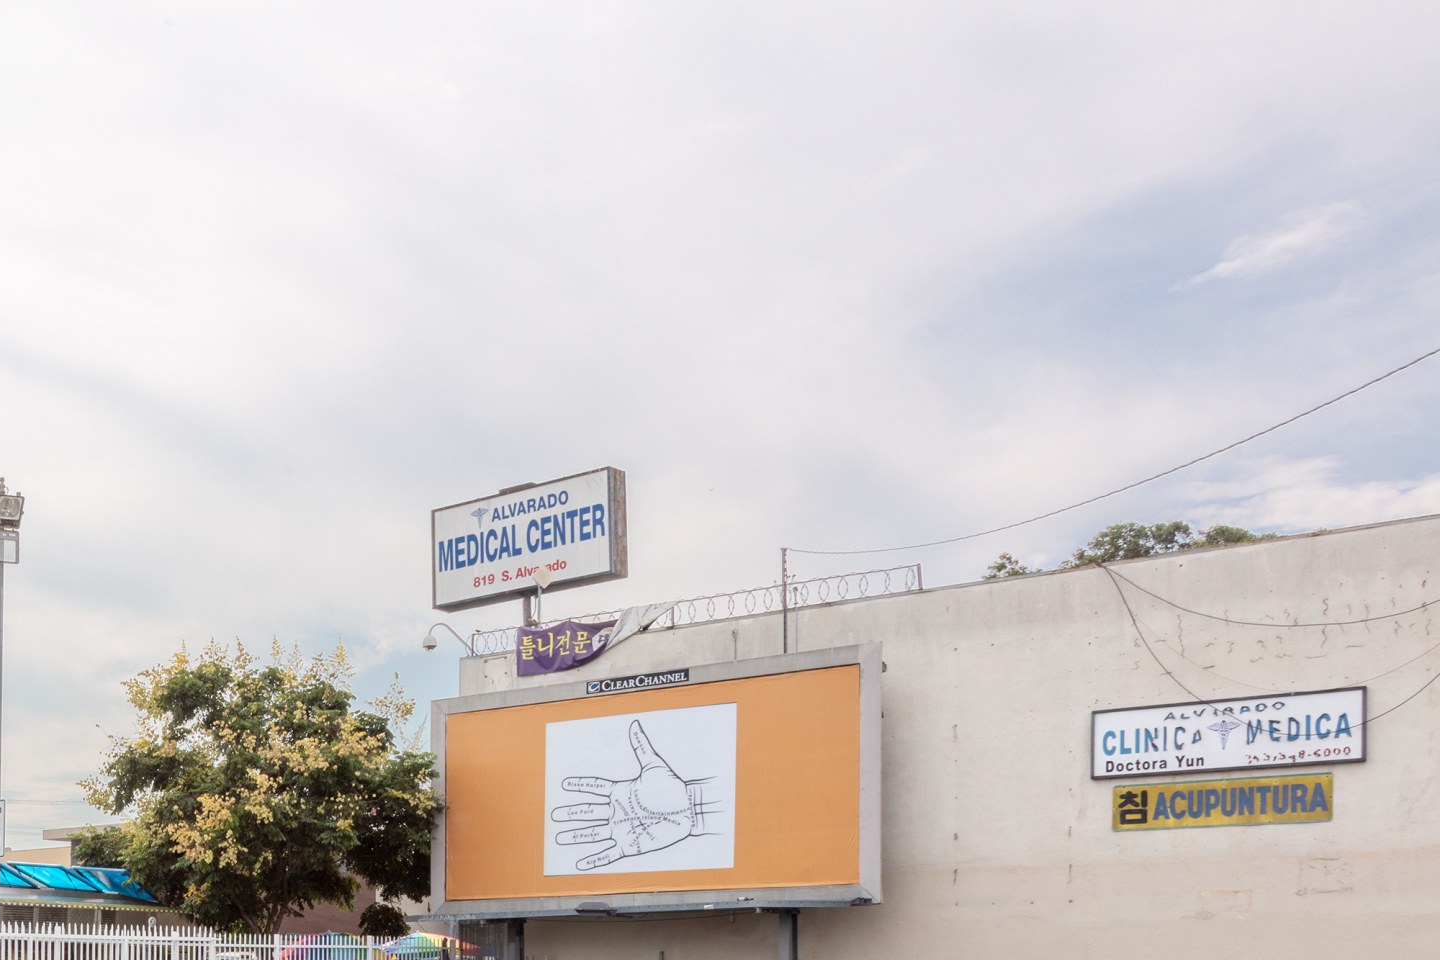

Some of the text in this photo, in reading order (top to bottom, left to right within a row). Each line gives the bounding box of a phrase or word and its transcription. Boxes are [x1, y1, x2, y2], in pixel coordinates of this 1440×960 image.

[491, 490, 569, 522] ALVARADO
[438, 503, 606, 573] MEDICAL CENTER
[473, 559, 567, 588] 819 S. Alvaado
[1102, 712, 1352, 756] CLINICA MEDICA
[1105, 755, 1205, 773] Doctora Yun
[1117, 790, 1148, 825] 침
[1153, 782, 1329, 821] ACUPUNTURA
